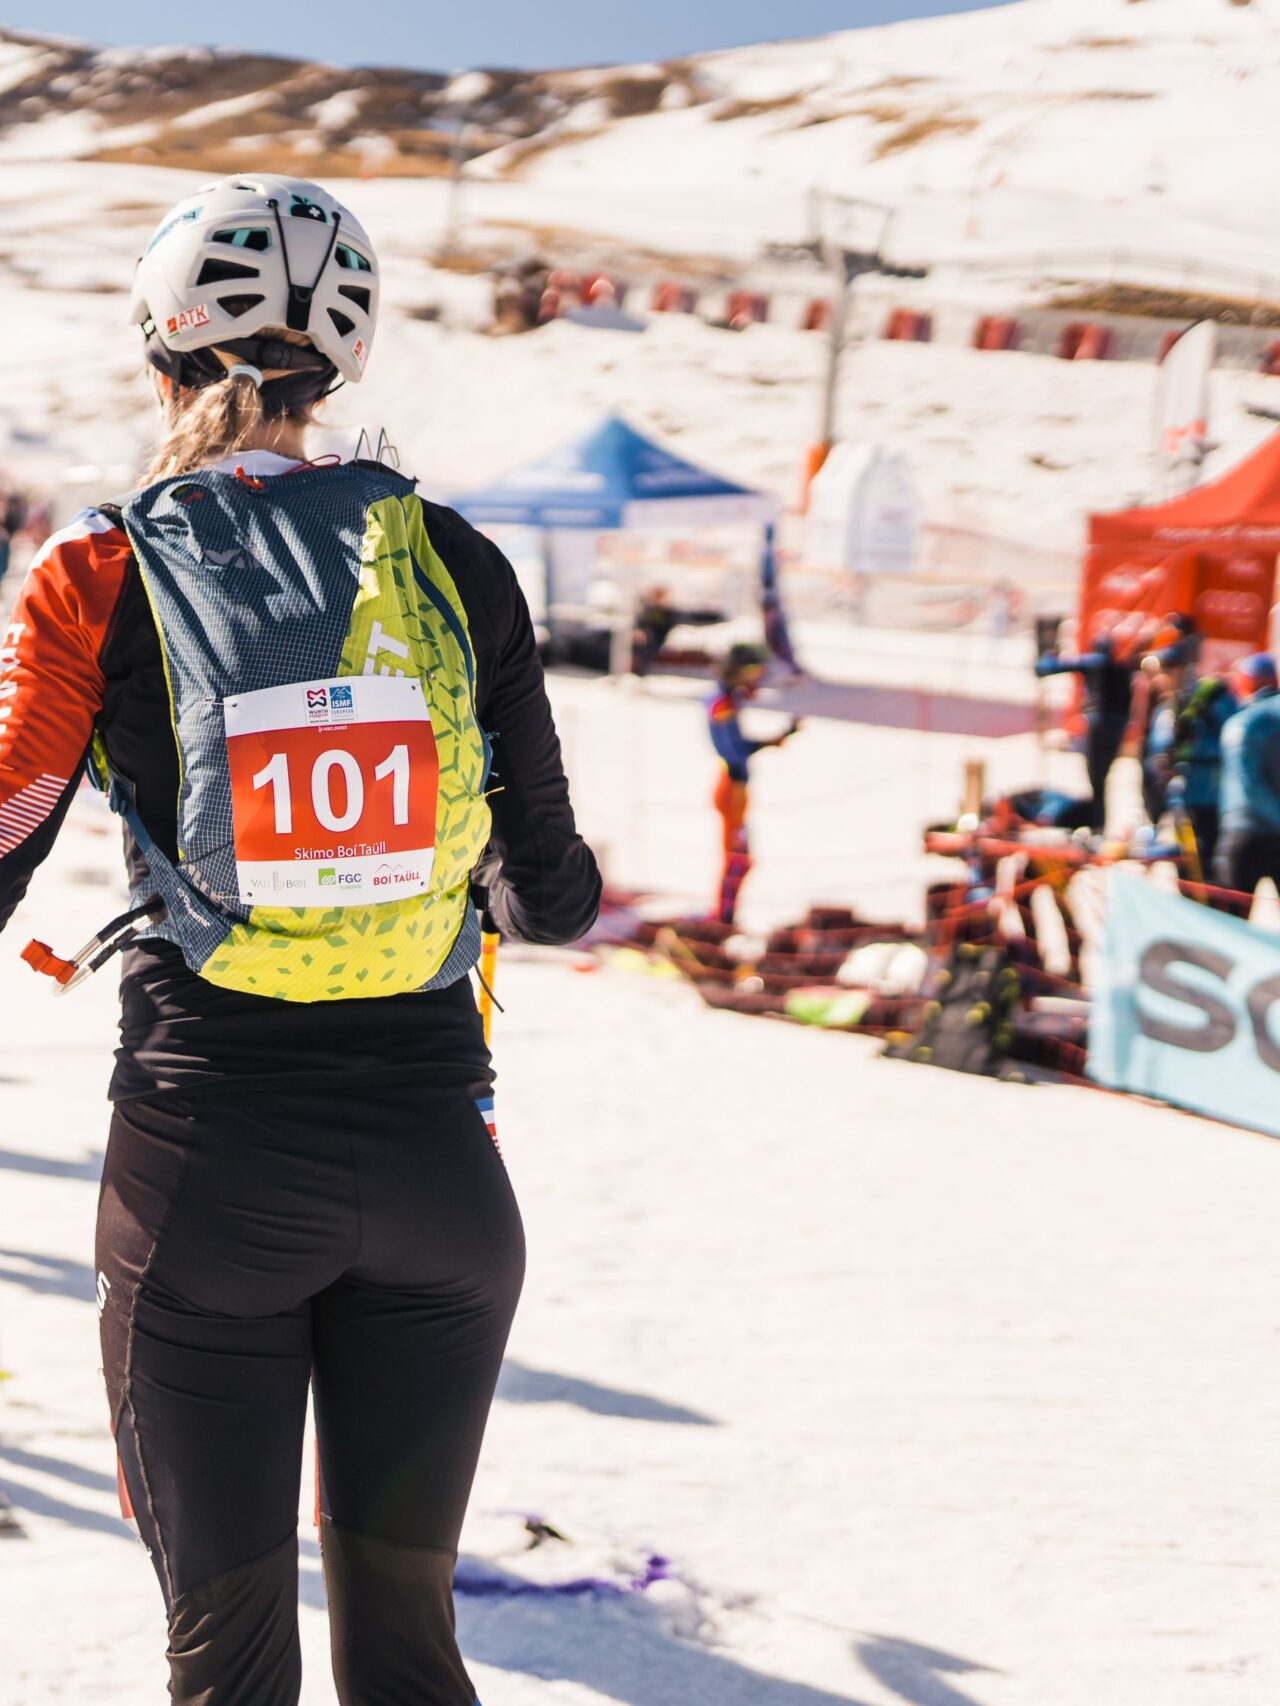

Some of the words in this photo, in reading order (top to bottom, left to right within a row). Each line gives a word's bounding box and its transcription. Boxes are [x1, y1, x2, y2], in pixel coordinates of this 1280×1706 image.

[179, 304, 207, 328] ATK
[332, 700, 351, 708] ISMF
[252, 744, 410, 835] 101
[294, 847, 334, 861] Skimo
[337, 843, 358, 857] Boí
[359, 841, 387, 855] Taüll
[338, 873, 362, 884] FGC
[394, 869, 421, 883] TAÜLL
